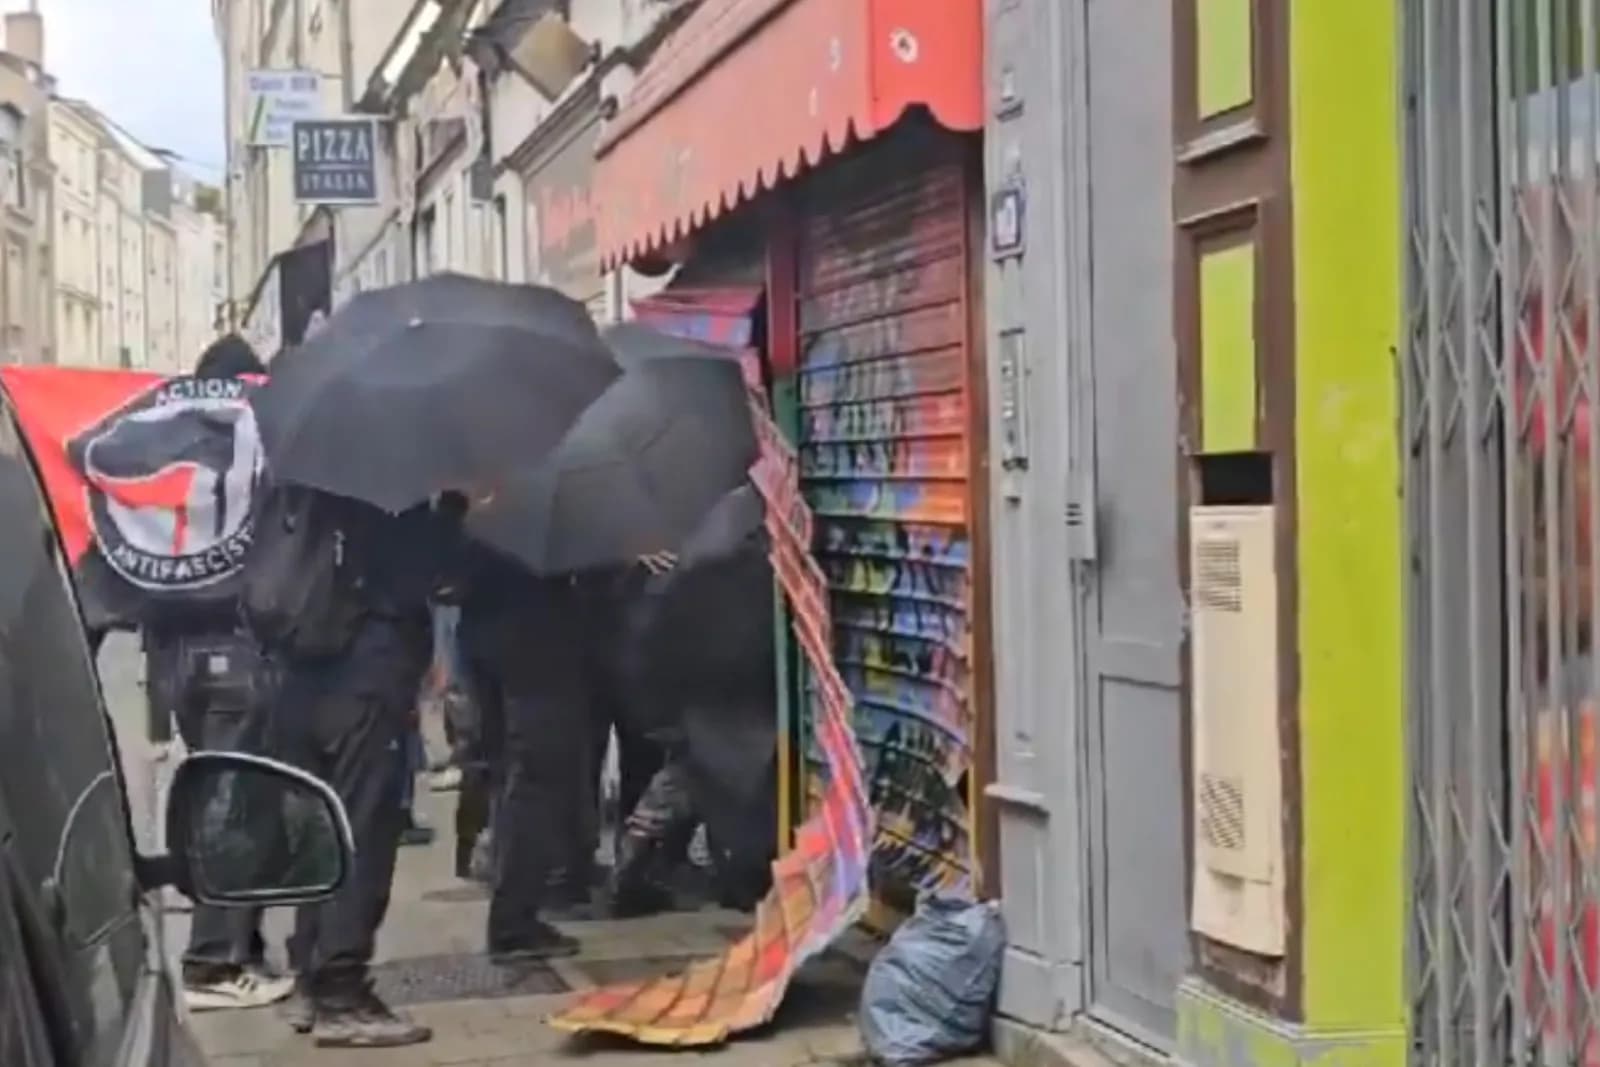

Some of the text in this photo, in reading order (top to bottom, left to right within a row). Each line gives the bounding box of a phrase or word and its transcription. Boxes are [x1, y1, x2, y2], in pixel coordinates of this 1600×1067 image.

[298, 129, 370, 162] PIZZA
[302, 173, 370, 192] ITALIA
[155, 378, 243, 407] ACTION
